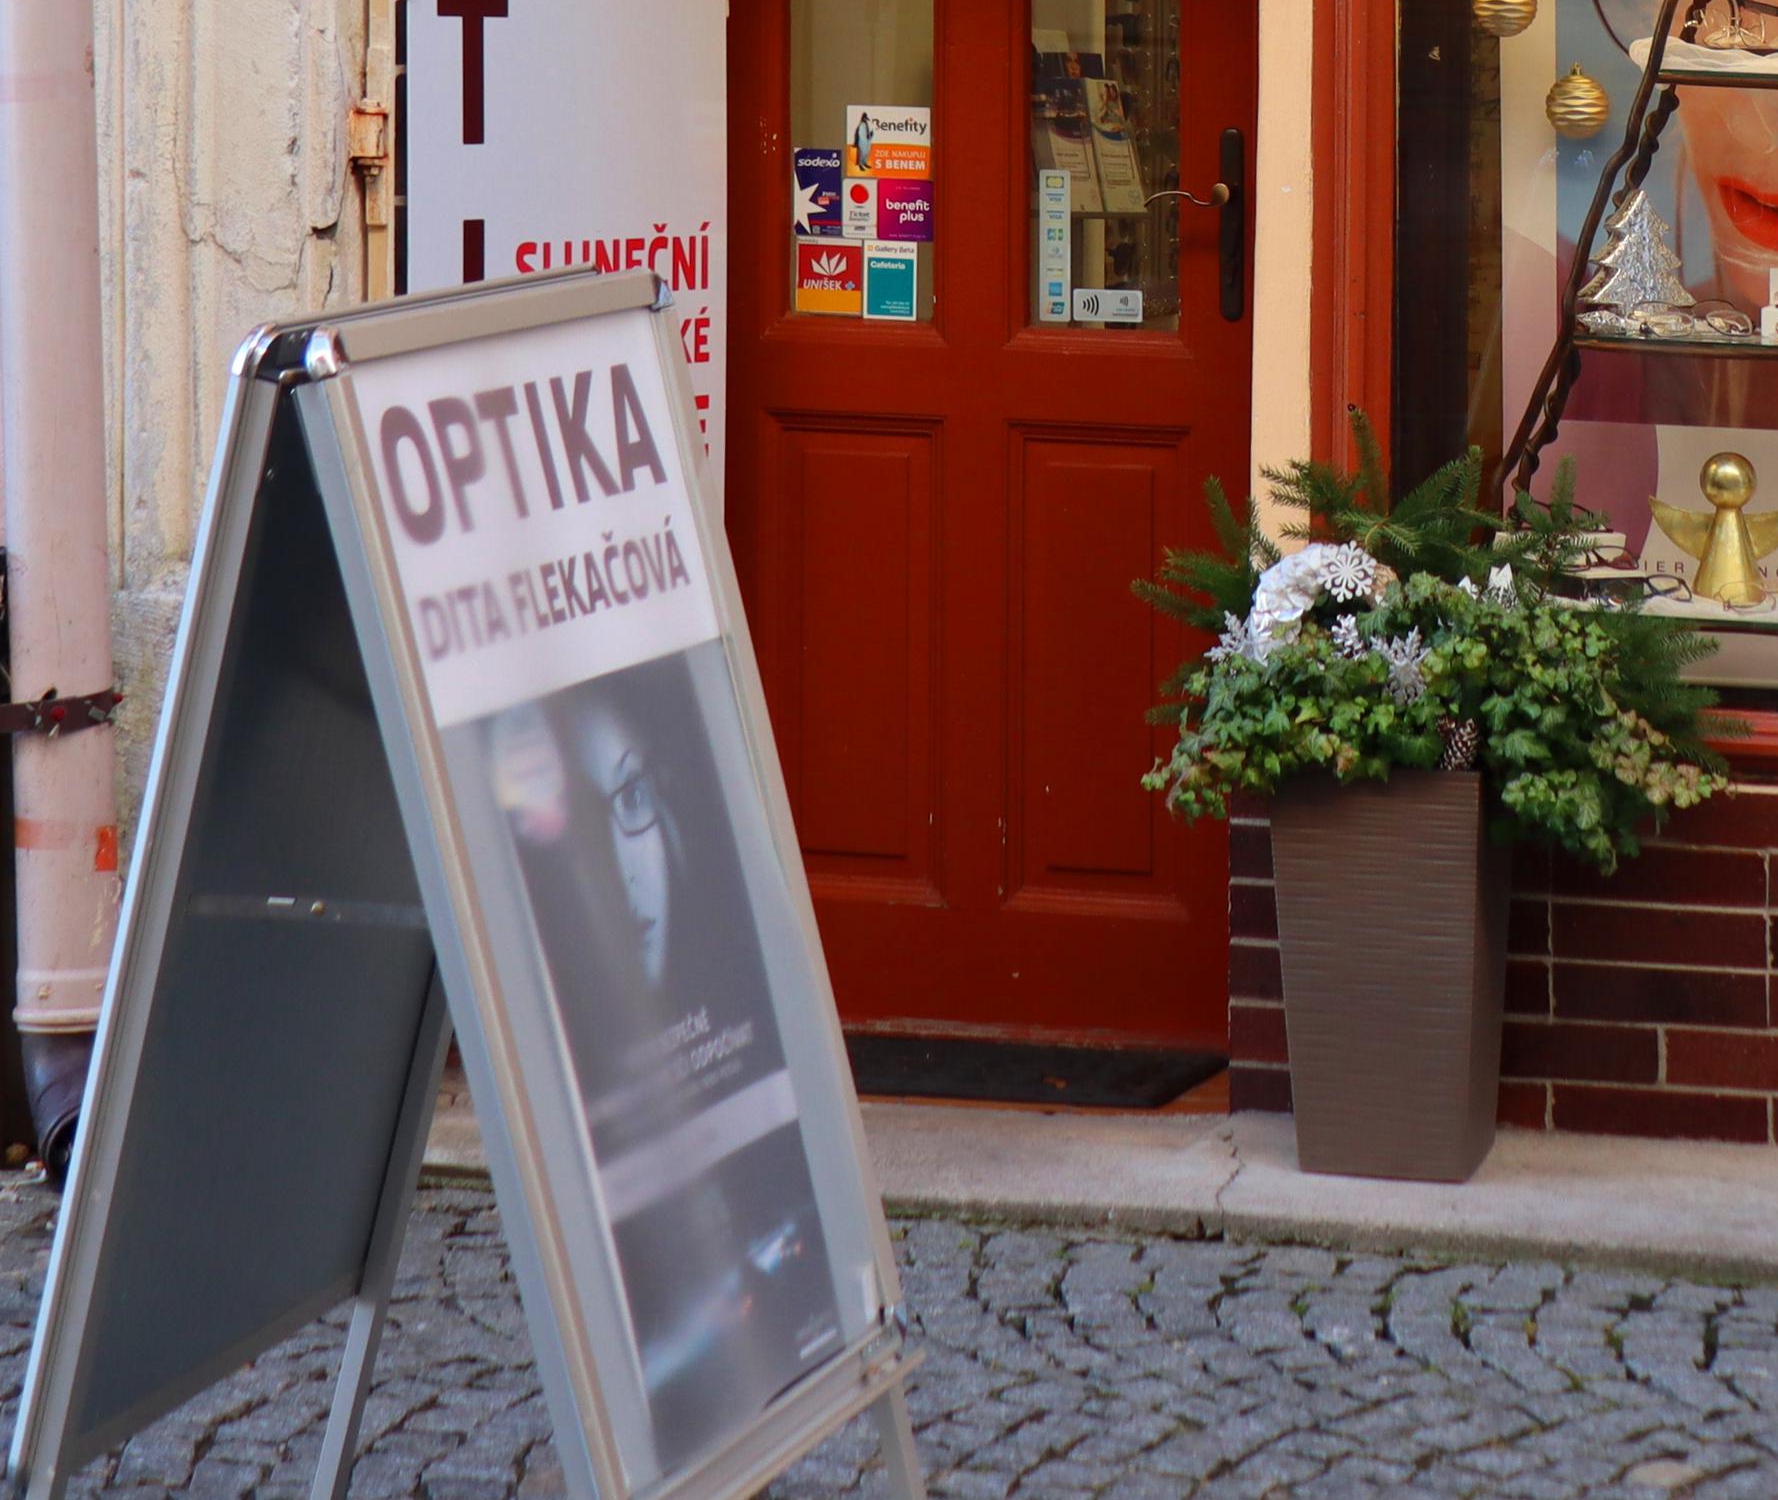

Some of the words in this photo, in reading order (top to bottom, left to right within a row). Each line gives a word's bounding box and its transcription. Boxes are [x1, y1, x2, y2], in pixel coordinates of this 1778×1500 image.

[797, 156, 840, 168] sodexo
[875, 159, 882, 169] S
[885, 160, 926, 170] BENEM
[886, 198, 930, 211] benefit
[899, 210, 924, 224] plus
[870, 260, 906, 270] Cafeteria
[378, 363, 667, 546] OPTIKA
[418, 575, 507, 663] DITA
[508, 516, 691, 636] FLEKAČOVÁ
